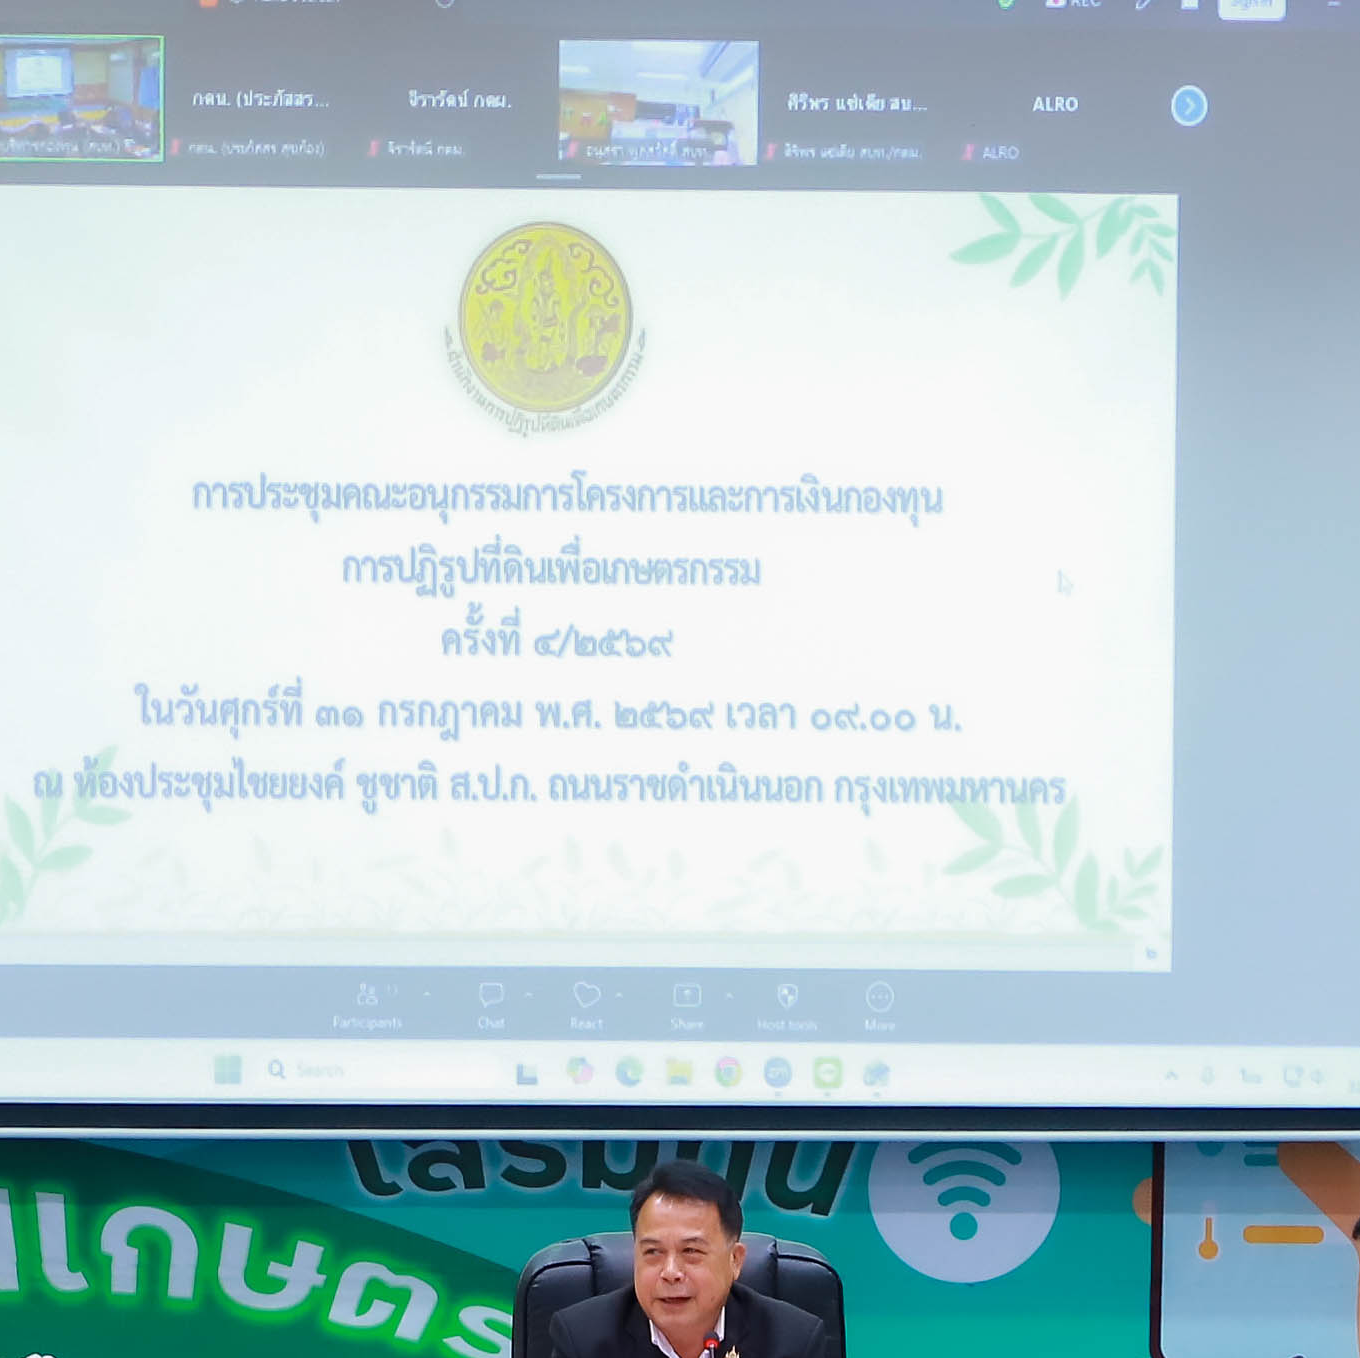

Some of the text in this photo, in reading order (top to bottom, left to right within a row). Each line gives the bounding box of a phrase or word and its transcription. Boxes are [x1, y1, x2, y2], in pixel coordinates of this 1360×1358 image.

[1032, 97, 1079, 112] ALRO
[983, 146, 1020, 159] ALRO
[192, 470, 944, 526] การประชุมคณะอนุกรรมการโครงการและการเงินกองทุน
[342, 535, 761, 598] การปฏิรูปที่ดินเพื่อเกษตรกรรม
[442, 602, 674, 657] ครั้งที่ ๔/๒๕๖๙
[134, 676, 962, 741] ในวันศุกร์ที่ ๓๑ กรกฎาคม พ.ศ. ๒๕๖๙ เวลา ๐๙.๐๐ น.
[33, 756, 1066, 817] ณ ห้องประชุมไชยยงค์ ชูชาติ ส.ป.ก. ถนนราชดำเนินนอก กรุงเทพมหานคร
[477, 1015, 506, 1030] Chat
[569, 1015, 605, 1031] React
